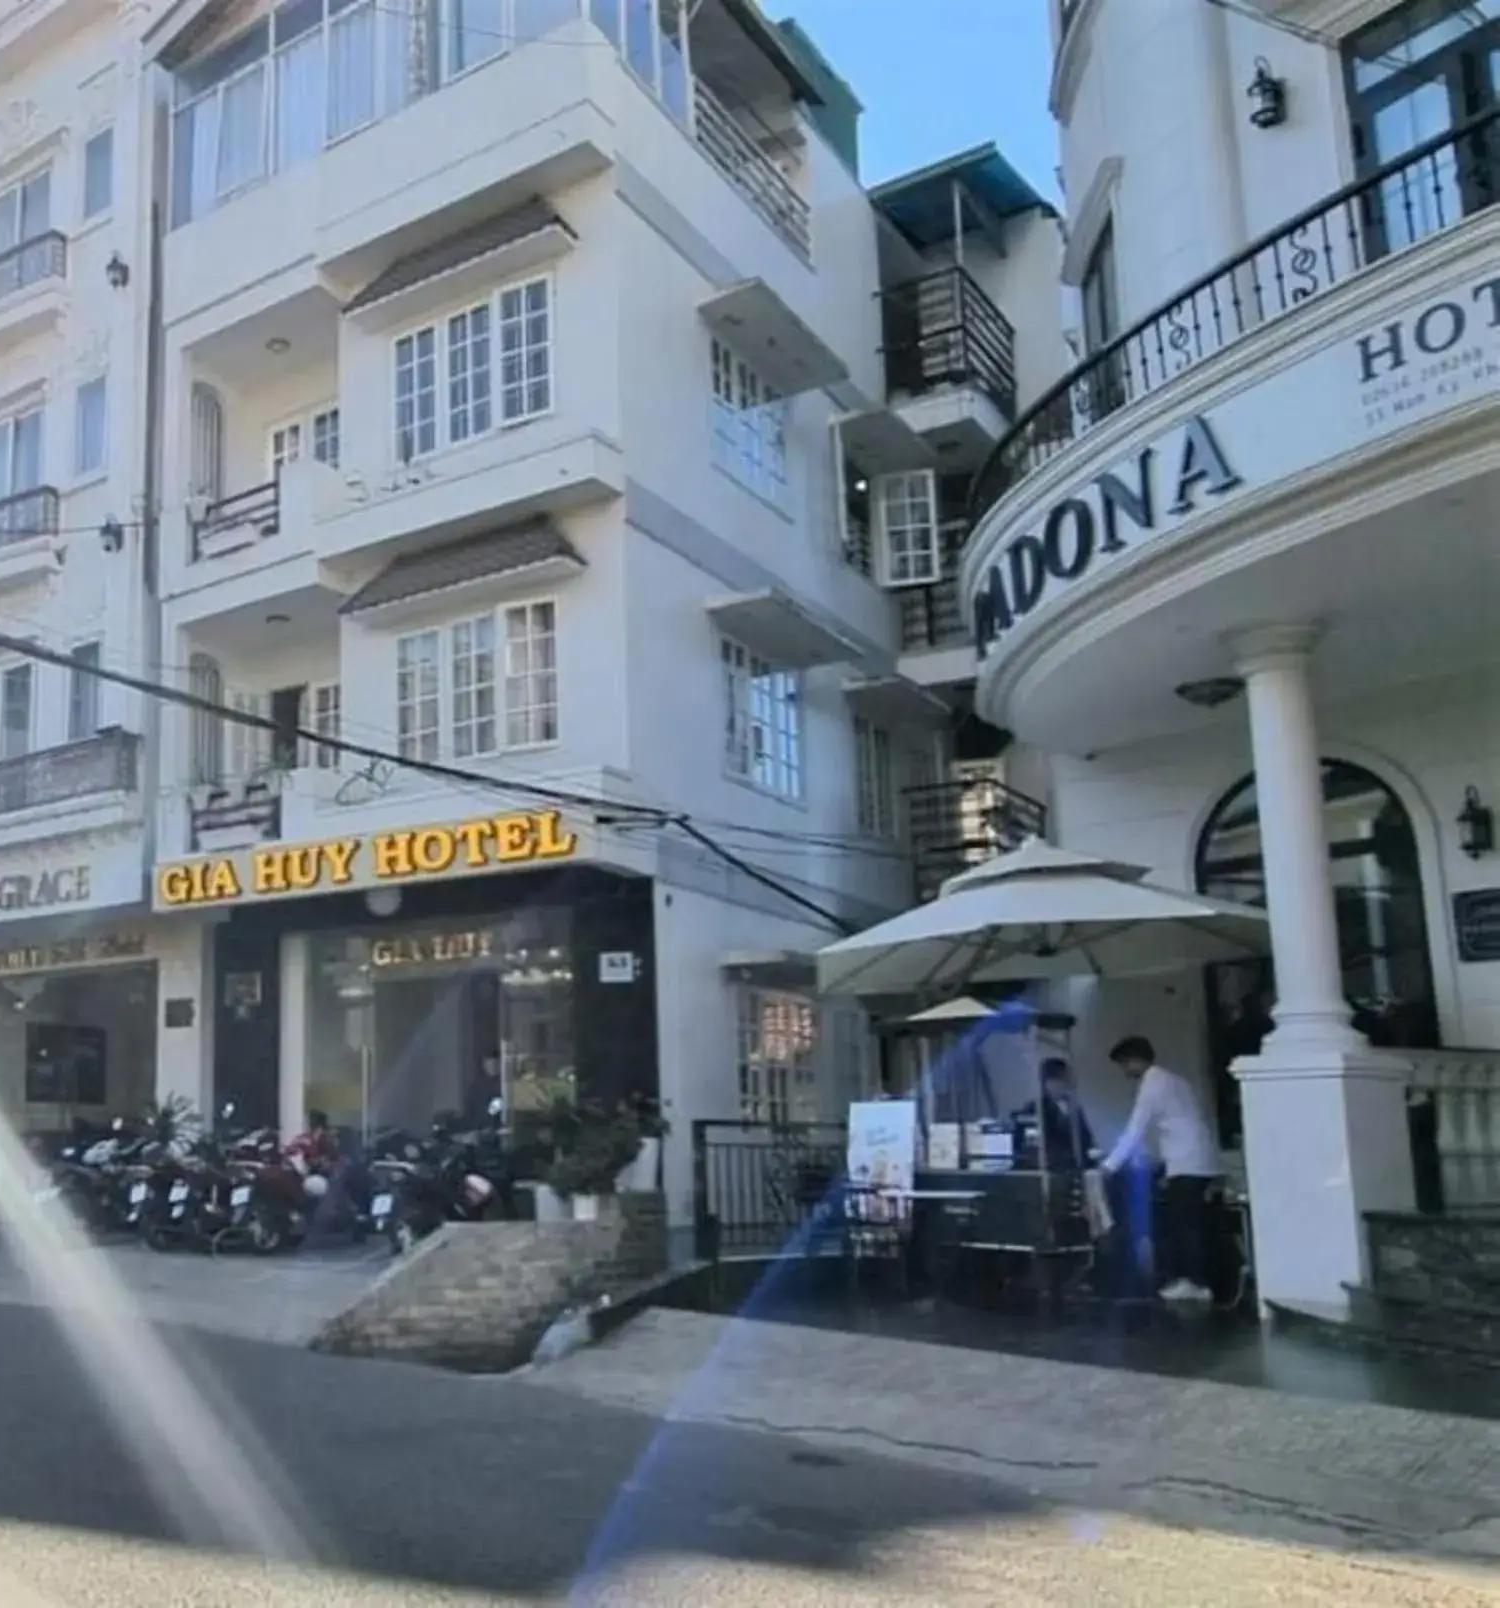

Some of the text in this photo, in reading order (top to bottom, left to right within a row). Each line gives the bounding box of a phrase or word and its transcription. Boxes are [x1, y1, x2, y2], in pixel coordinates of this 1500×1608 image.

[160, 807, 578, 906] GIA HUY HOTEL
